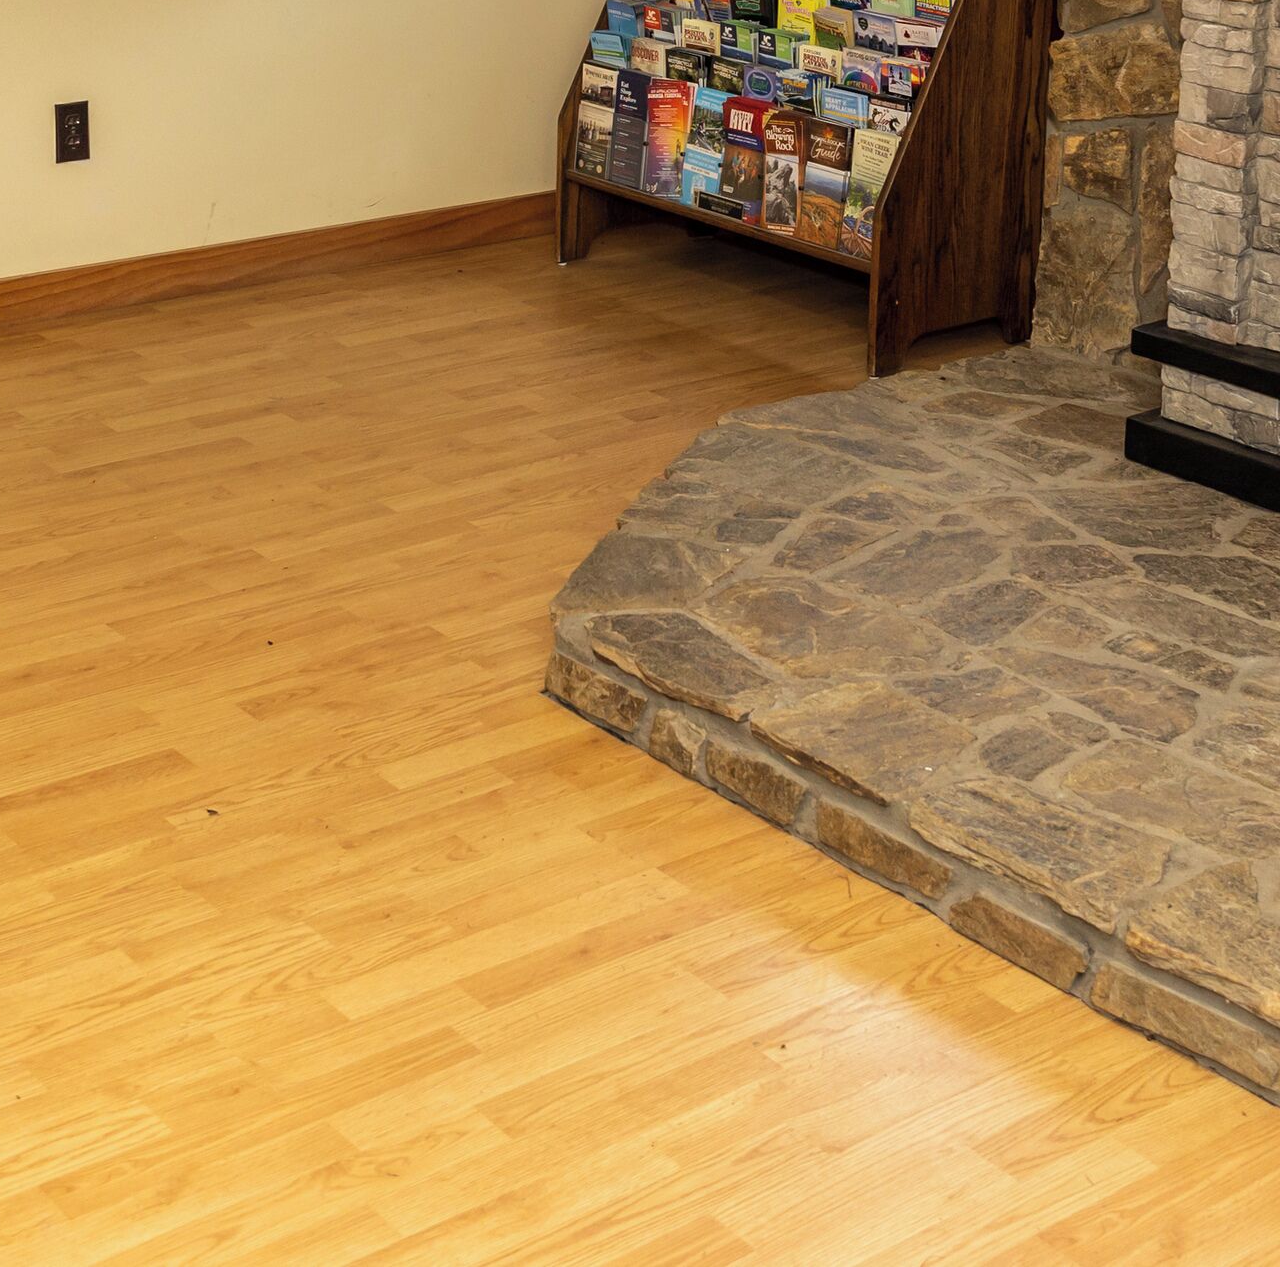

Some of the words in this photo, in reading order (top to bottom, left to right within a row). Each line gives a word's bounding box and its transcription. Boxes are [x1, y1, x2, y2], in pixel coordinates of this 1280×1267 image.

[917, 1, 950, 13] ATTRACTIONS
[772, 125, 781, 133] The
[766, 129, 795, 143] Blowing
[775, 140, 794, 151] Rock
